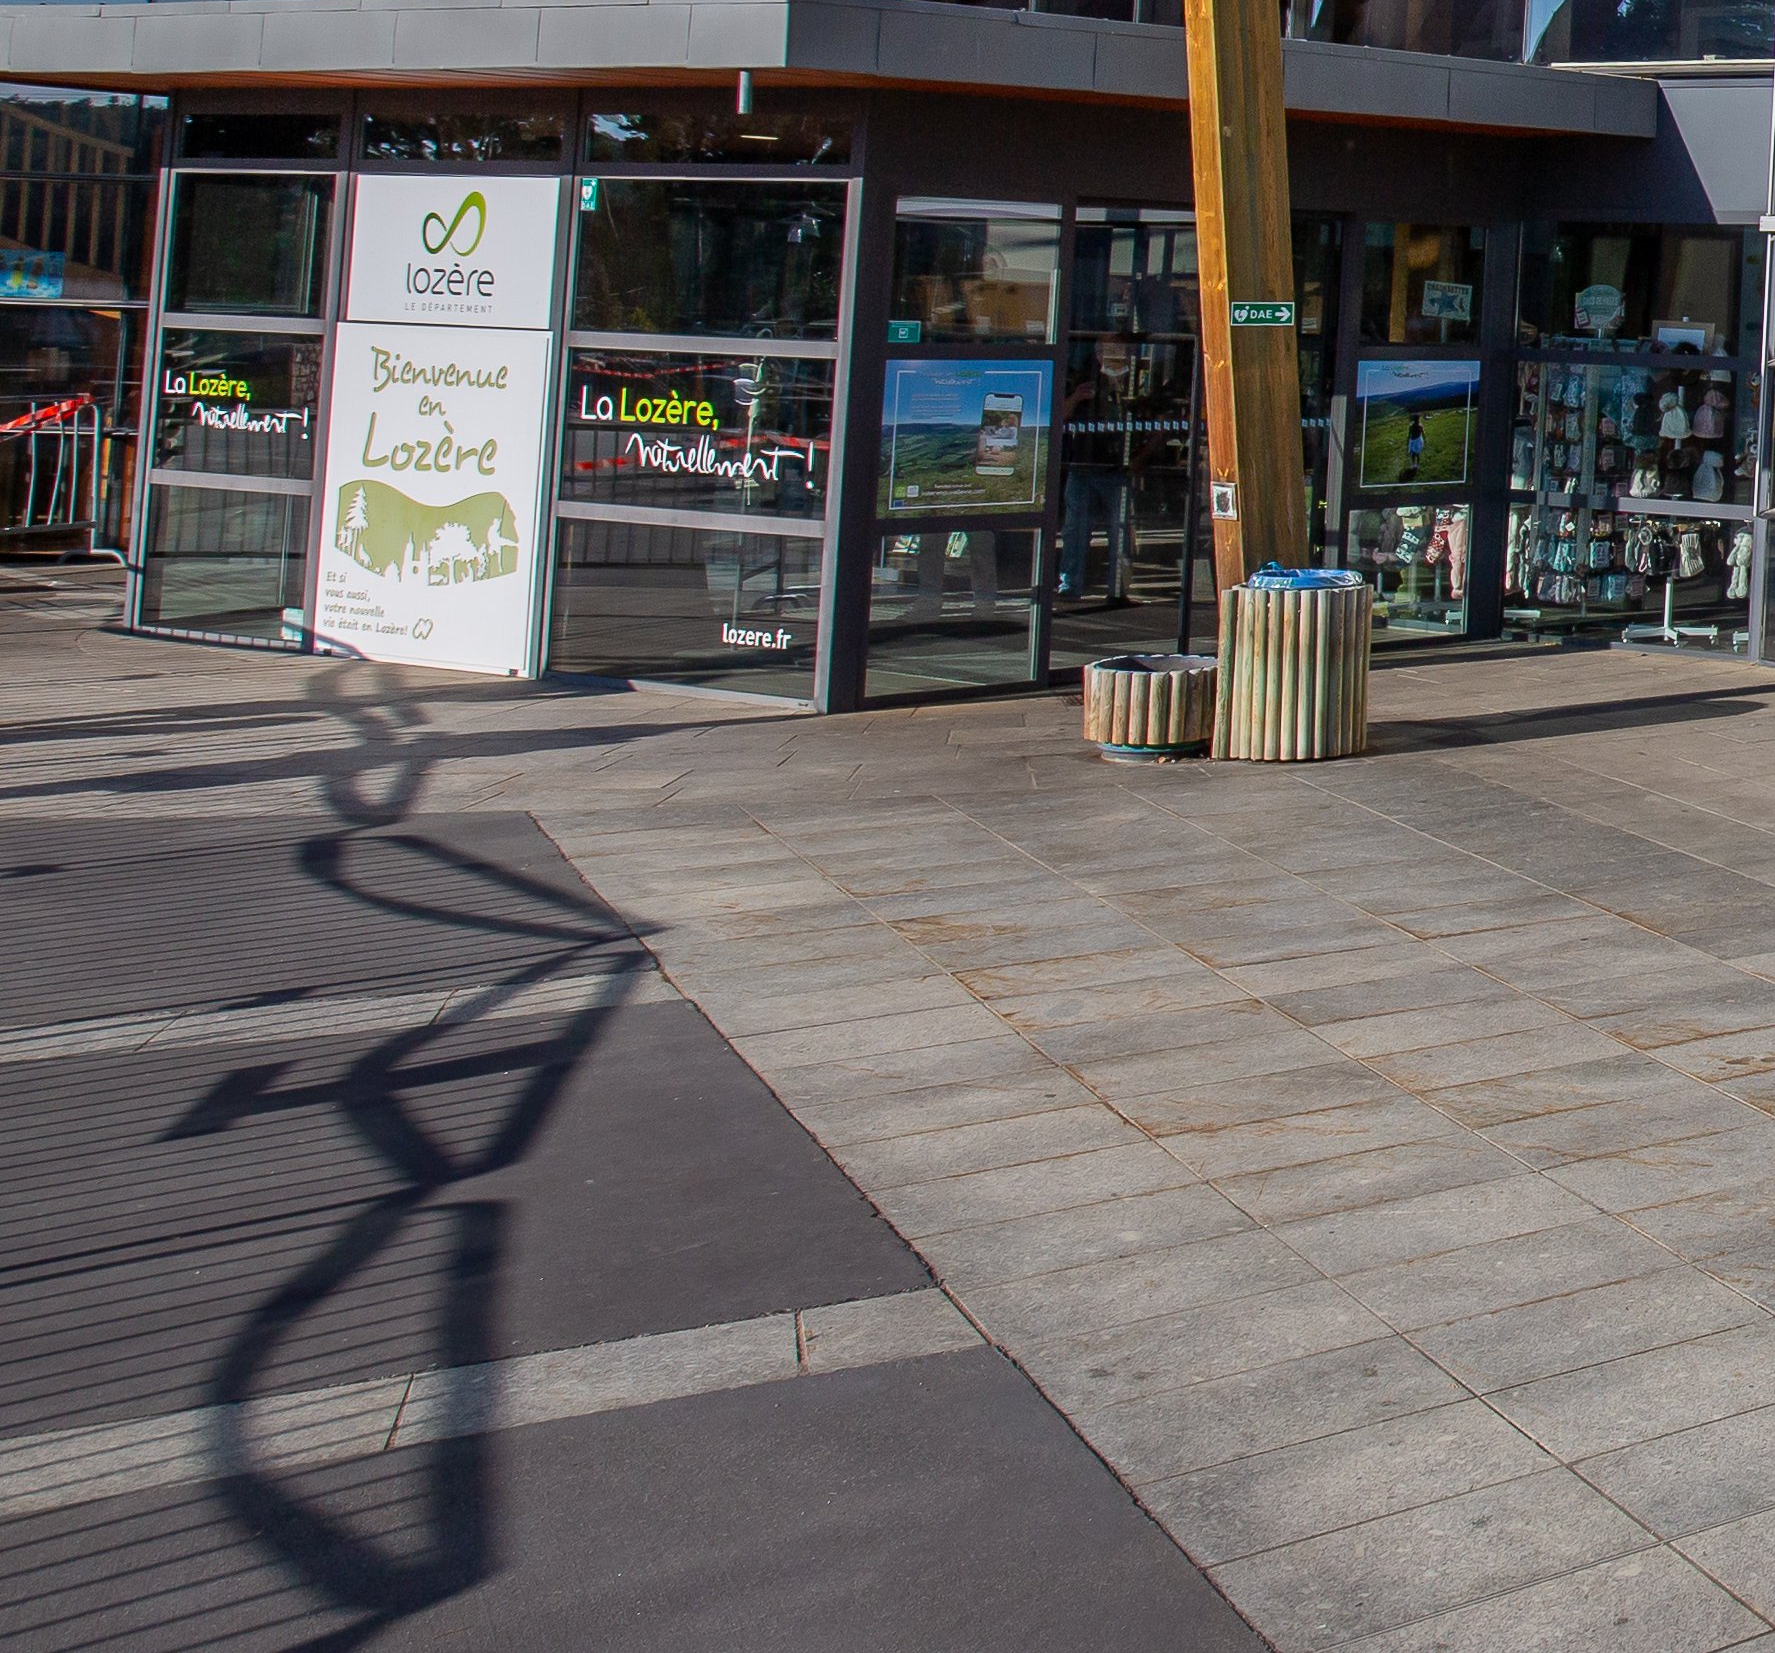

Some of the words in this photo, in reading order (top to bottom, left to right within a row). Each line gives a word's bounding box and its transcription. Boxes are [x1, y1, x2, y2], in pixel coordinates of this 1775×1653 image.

[407, 262, 495, 297] lozère
[404, 302, 416, 311] LE
[421, 301, 494, 314] DÉPARTEMENT
[1249, 309, 1273, 319] DAE
[371, 346, 508, 393] Bienvenue
[164, 369, 186, 394] La
[188, 371, 251, 401] Lozère,
[419, 395, 446, 416] en
[580, 385, 614, 420] La
[619, 386, 720, 432] Lozère,
[362, 411, 498, 476] Lozère
[326, 571, 336, 582] Et
[338, 572, 347, 583] si
[325, 588, 344, 598] vous
[324, 603, 346, 614] votre
[349, 606, 385, 617] nouvelle
[323, 617, 335, 627] vie
[362, 623, 372, 631] en
[722, 622, 792, 650] lozere.fr
